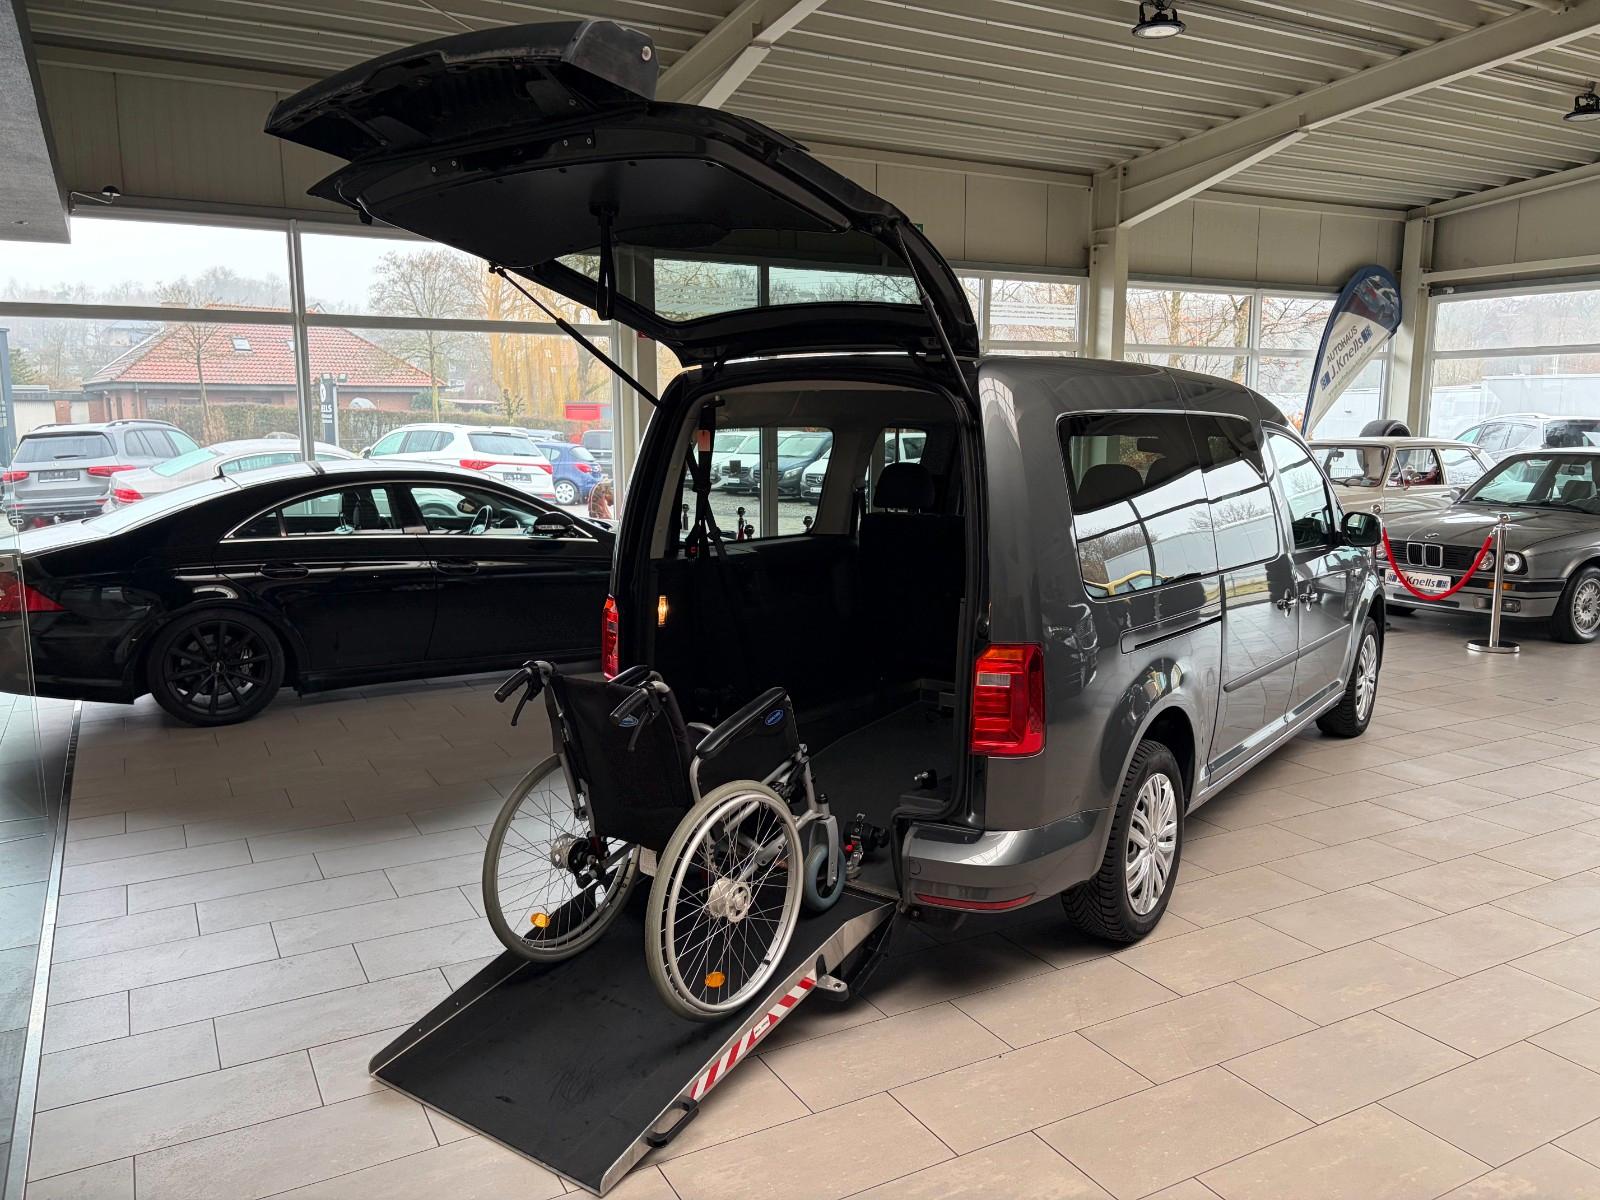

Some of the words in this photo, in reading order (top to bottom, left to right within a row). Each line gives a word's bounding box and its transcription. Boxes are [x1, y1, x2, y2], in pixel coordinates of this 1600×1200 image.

[1326, 325, 1358, 366] AUTOHAUS
[1330, 337, 1364, 380] J.Knells
[1398, 575, 1436, 588] Knells
